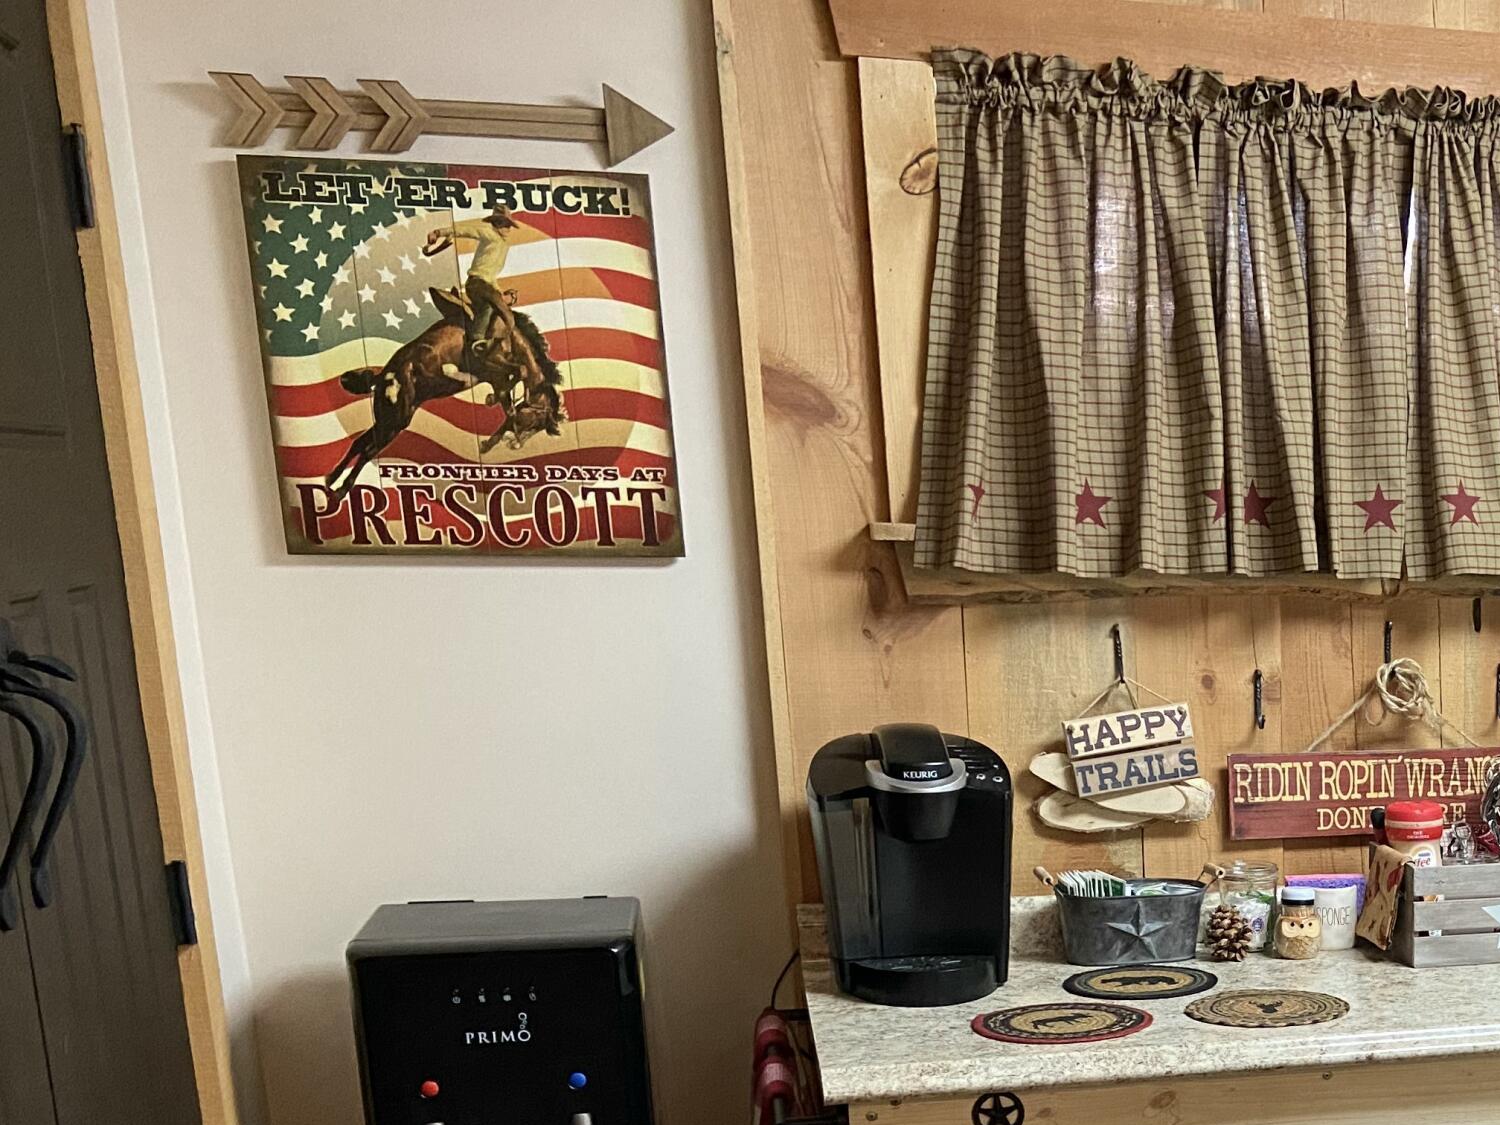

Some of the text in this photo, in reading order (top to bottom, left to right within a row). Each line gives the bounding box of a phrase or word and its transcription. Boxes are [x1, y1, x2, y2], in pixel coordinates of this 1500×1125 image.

[261, 172, 631, 217] LET 'ER BUCK!
[379, 464, 666, 482] FRONTIER DAYS AT
[296, 482, 667, 548] PRESCOTT
[1068, 709, 1188, 756] HAPPY
[903, 770, 938, 779] KEURIG
[1076, 748, 1199, 794] TRAILS
[1233, 761, 1313, 803] RIDIN
[1316, 906, 1352, 926] SPONGE
[465, 1029, 531, 1044] PRIMO
